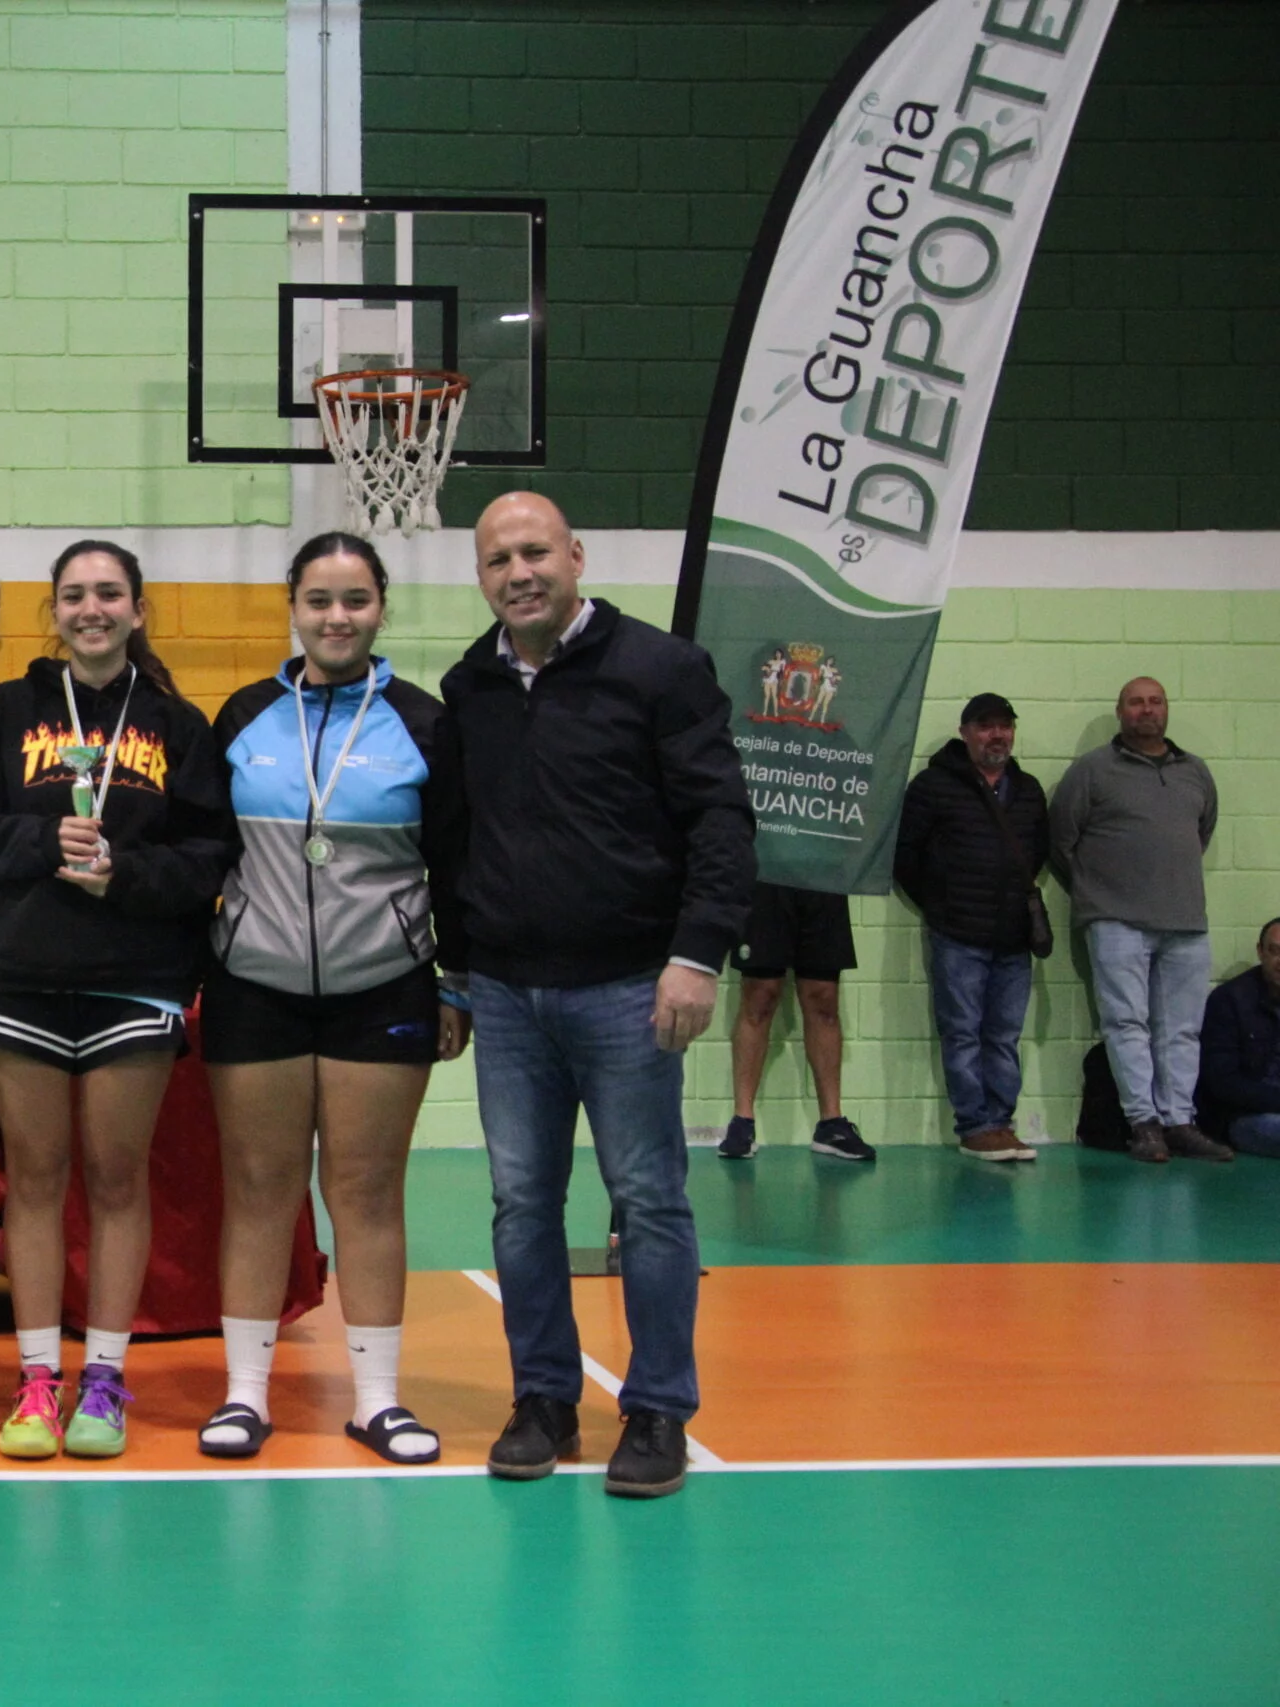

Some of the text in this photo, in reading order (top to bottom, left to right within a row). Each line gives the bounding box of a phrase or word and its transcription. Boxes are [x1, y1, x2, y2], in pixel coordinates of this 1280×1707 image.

[778, 99, 939, 515] La Guancha
[836, 532, 867, 564] es
[783, 739, 803, 756] de
[806, 742, 874, 766] Deportes
[842, 774, 869, 797] de
[750, 789, 864, 826] UANCHA
[756, 819, 797, 836] Tenerife
